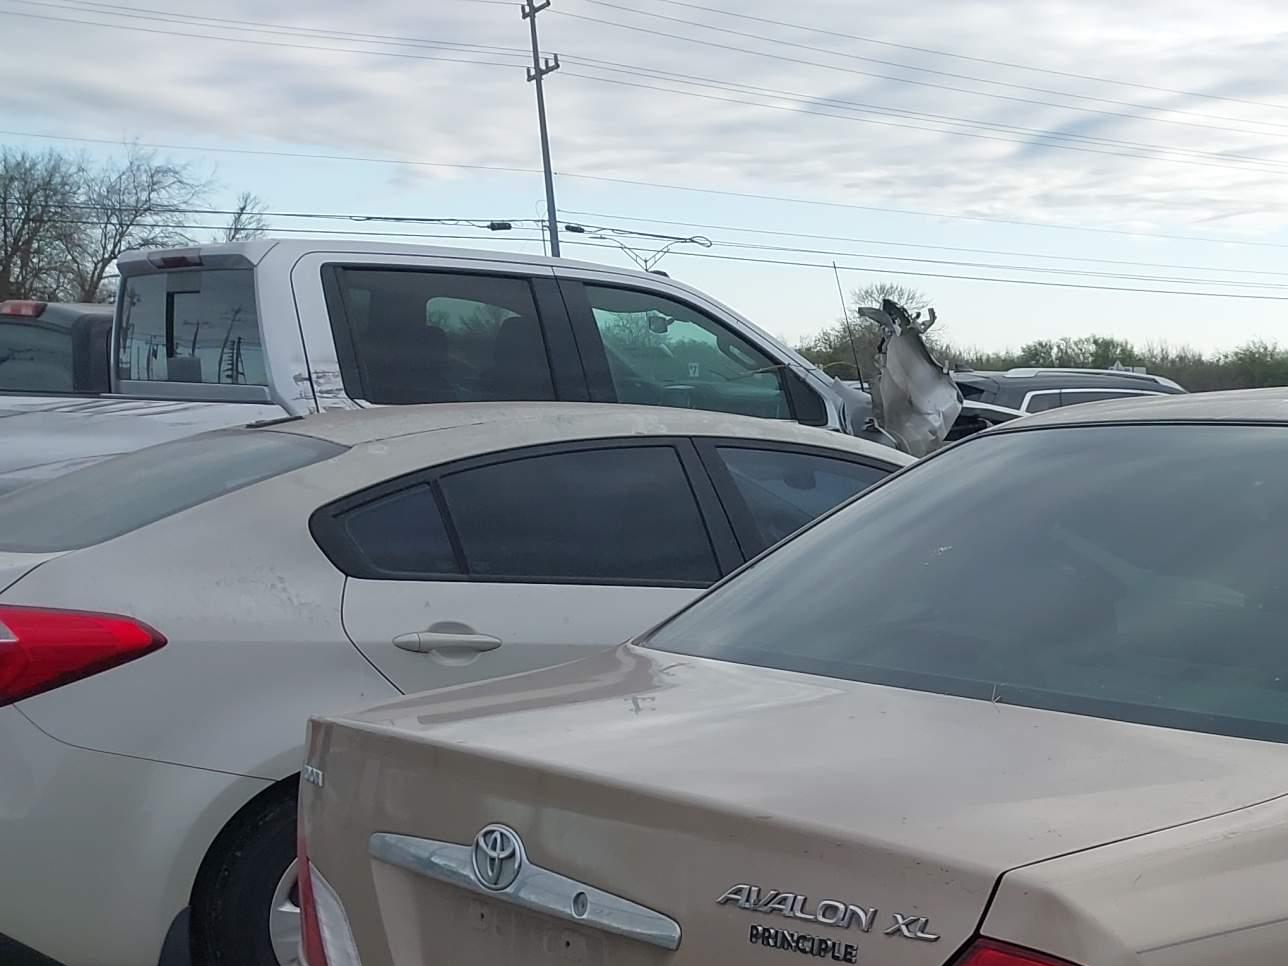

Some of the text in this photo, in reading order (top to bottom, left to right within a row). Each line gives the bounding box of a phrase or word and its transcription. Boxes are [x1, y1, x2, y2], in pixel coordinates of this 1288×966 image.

[715, 883, 941, 942] AVALON XL
[749, 923, 859, 964] PRINCIPLE
